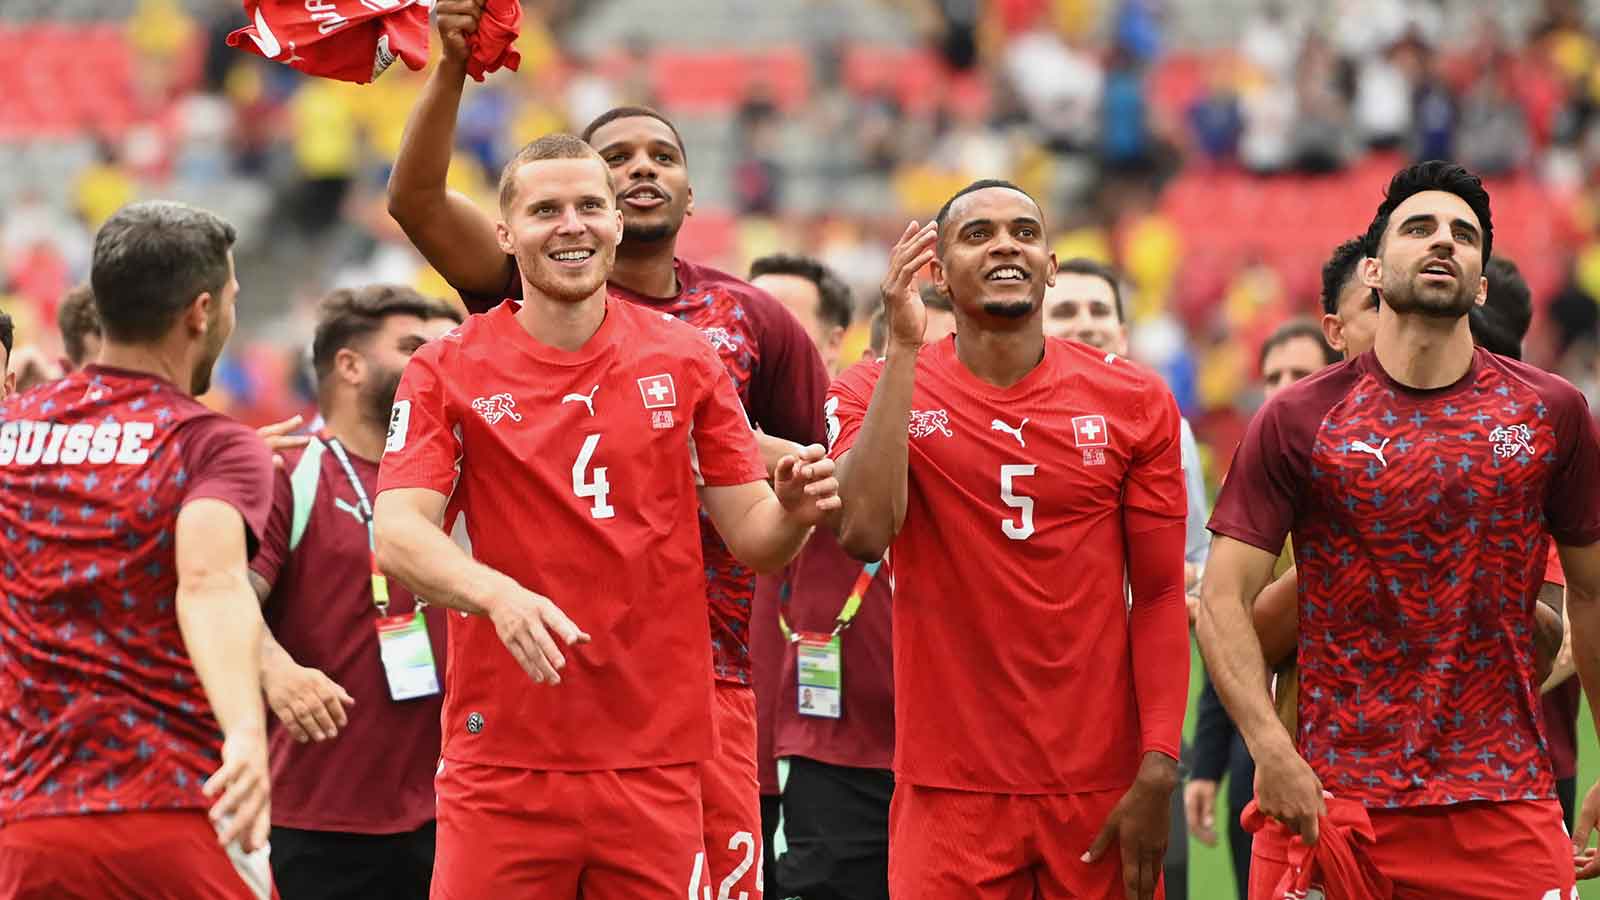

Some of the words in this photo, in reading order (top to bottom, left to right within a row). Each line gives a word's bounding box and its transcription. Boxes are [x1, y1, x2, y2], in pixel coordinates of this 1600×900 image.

[0, 420, 154, 465] SUISSE
[572, 433, 615, 519] 4
[1001, 464, 1037, 540] 5
